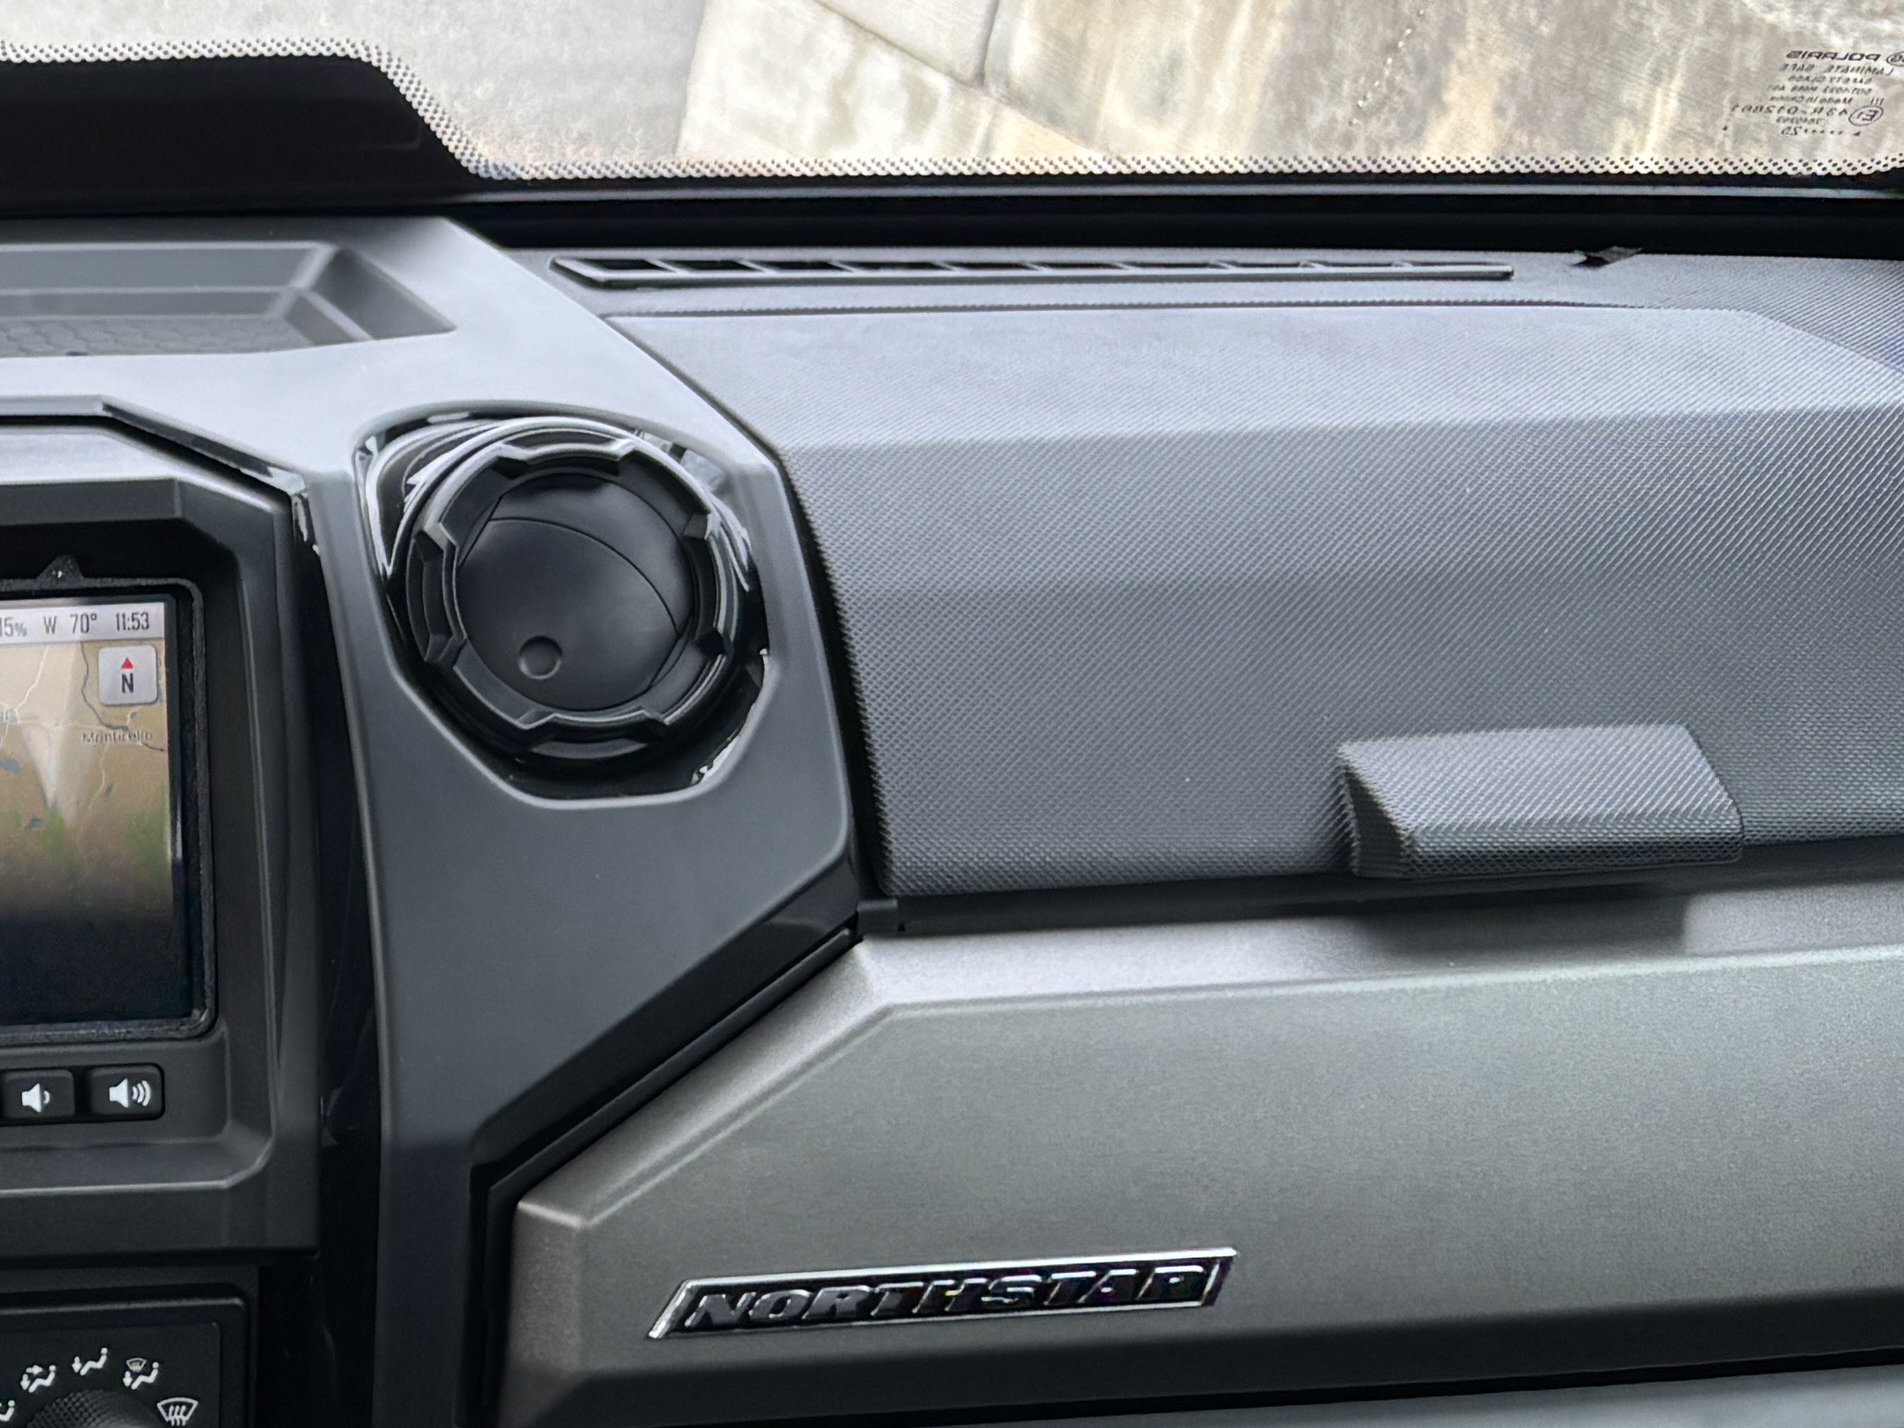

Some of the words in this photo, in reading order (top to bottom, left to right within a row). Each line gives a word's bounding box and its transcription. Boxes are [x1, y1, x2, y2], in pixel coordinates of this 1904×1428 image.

[43, 615, 56, 634] W
[70, 612, 98, 634] 70°
[115, 612, 150, 631] 11:53
[122, 673, 134, 694] N
[684, 1263, 1206, 1329] NORTHSTAR
